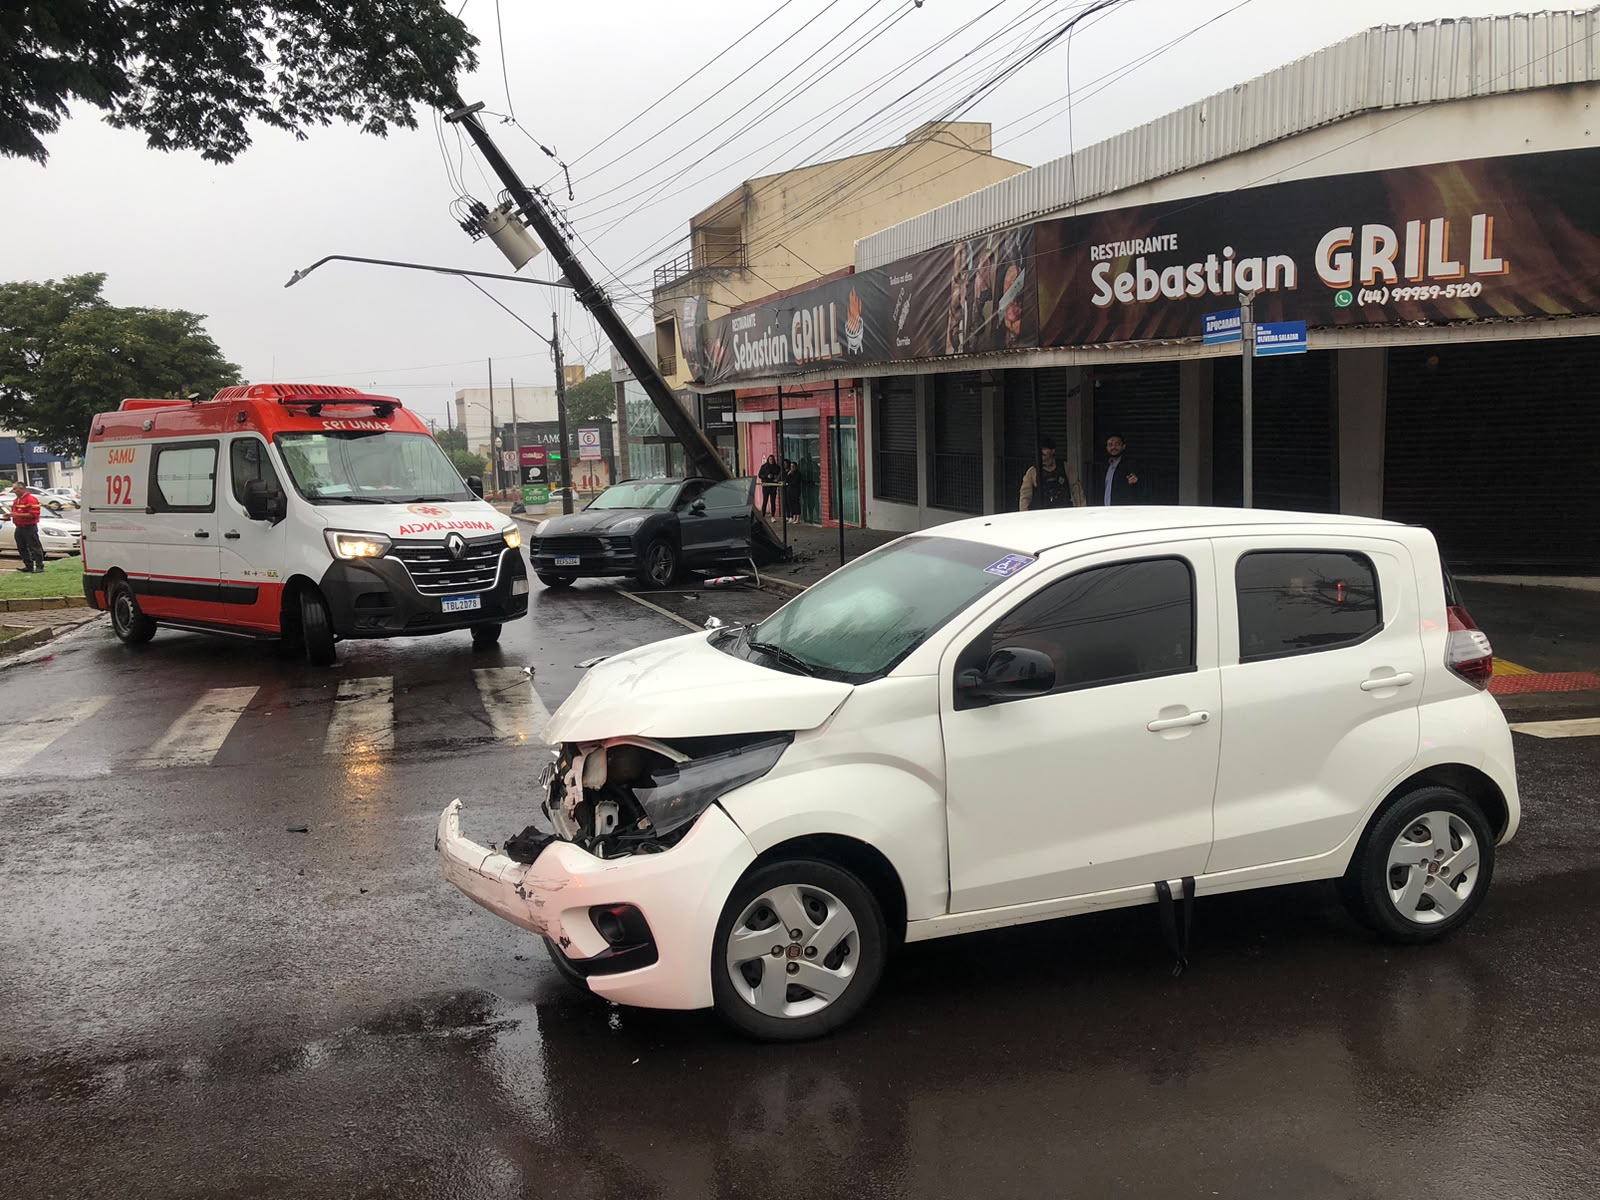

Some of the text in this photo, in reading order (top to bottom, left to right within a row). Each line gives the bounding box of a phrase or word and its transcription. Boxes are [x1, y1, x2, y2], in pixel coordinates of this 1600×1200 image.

[1090, 233, 1178, 262] RESTAURANTE
[1315, 213, 1510, 288] GRILL
[1090, 245, 1298, 308] Sebastian
[1357, 287, 1389, 306] (44)
[733, 325, 788, 372] Sebastian
[791, 302, 842, 365] GRILL
[537, 433, 575, 444] LAMOE
[108, 448, 136, 465] SAMU
[106, 475, 132, 505] 192
